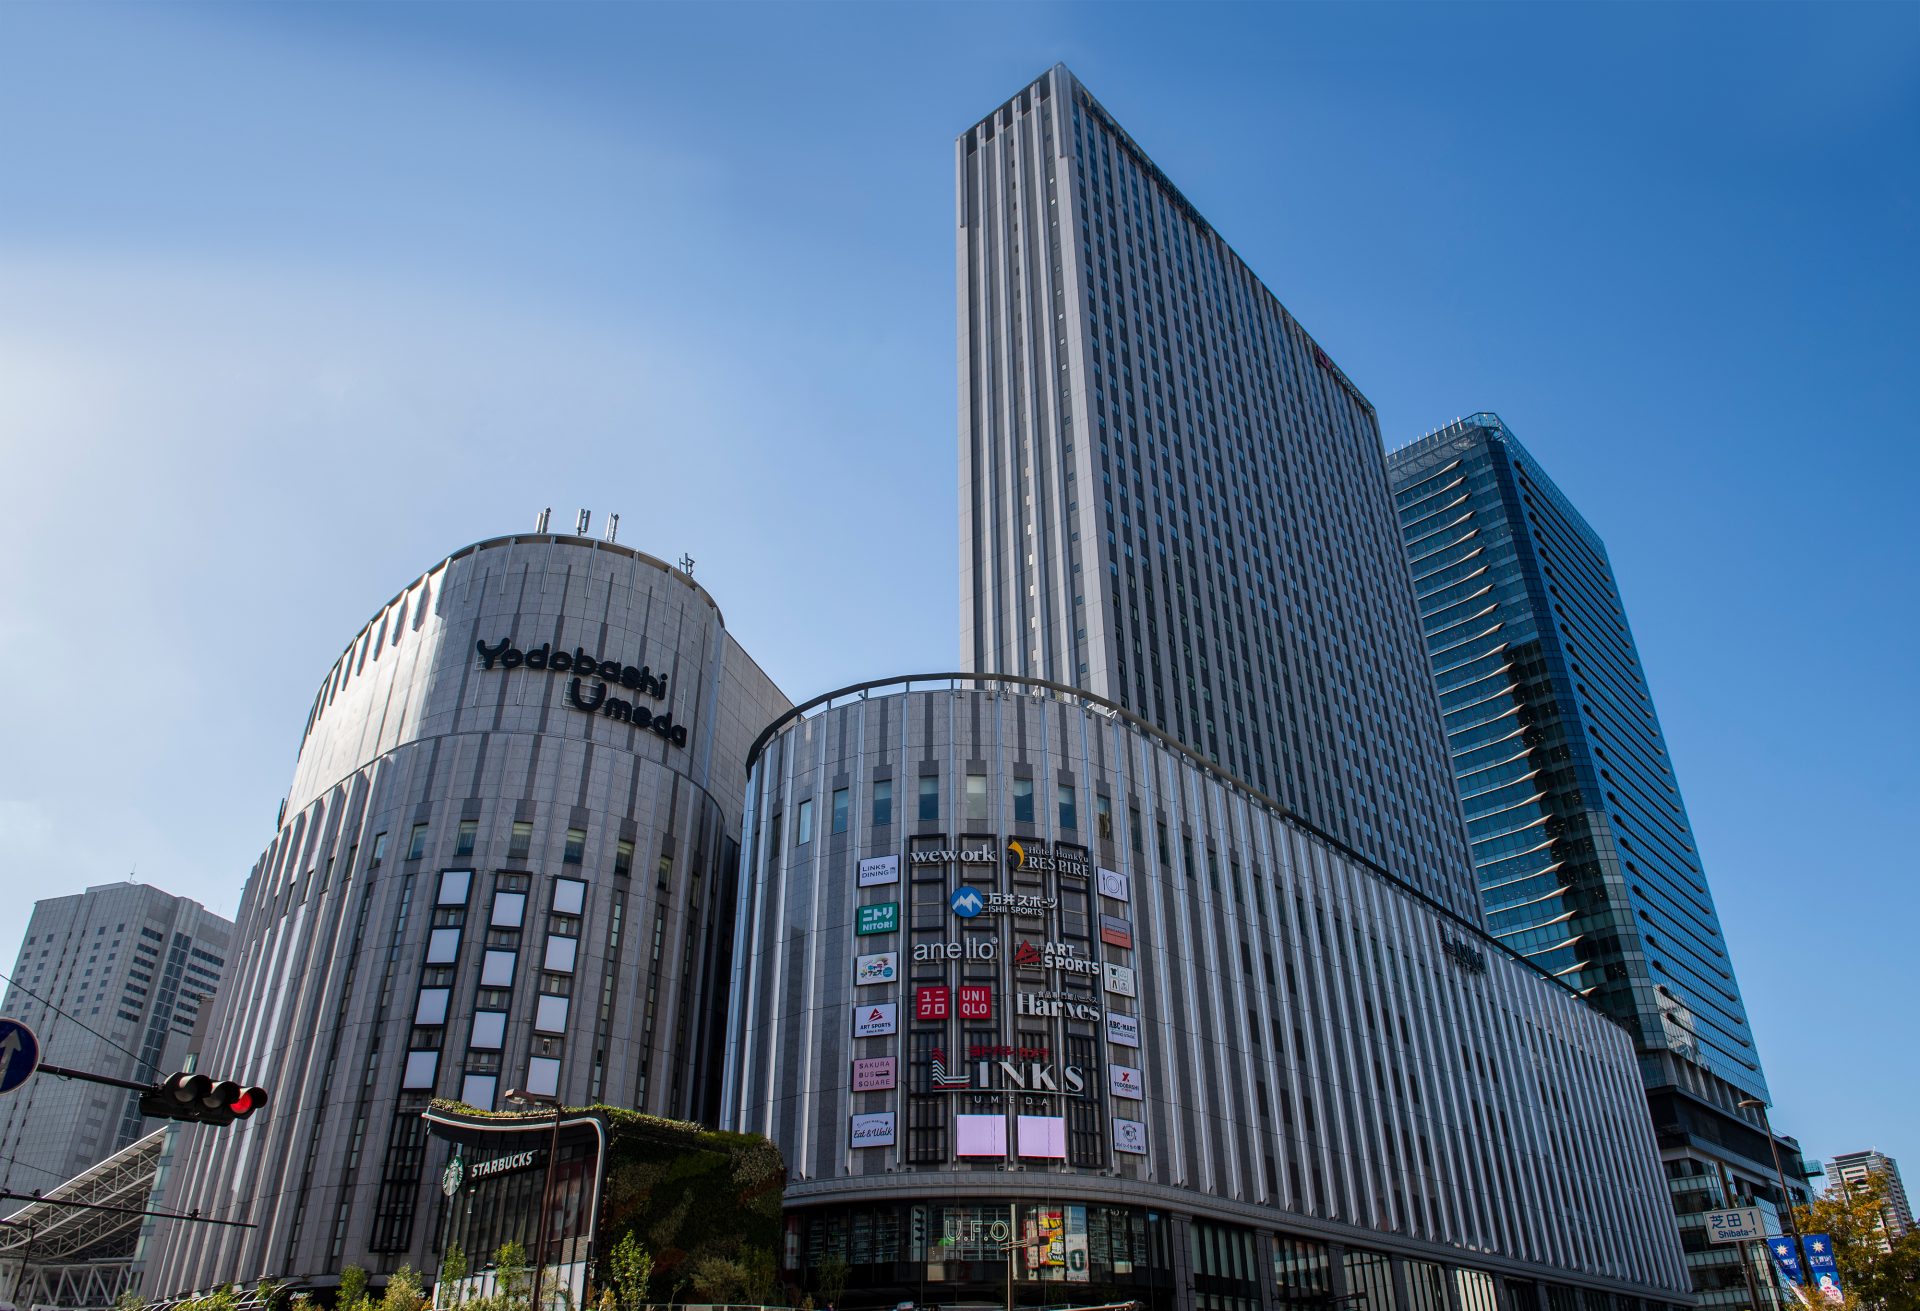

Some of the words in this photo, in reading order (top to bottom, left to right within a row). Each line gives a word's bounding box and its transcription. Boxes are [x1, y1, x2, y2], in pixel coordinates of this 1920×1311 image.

[477, 637, 668, 700] Yodobashi
[571, 677, 688, 748] Umeda
[910, 843, 997, 863] wework
[1028, 846, 1053, 855] Hotel
[1056, 849, 1089, 863] Hankyu
[862, 863, 886, 872] LINKS
[1028, 856, 1090, 876] RESPIRE
[862, 869, 889, 878] DINING
[988, 893, 1058, 909] 石井スポーツ
[862, 906, 893, 922] ニトリ
[988, 905, 1008, 913] ISHII
[1010, 906, 1044, 916] SPORTS
[862, 921, 893, 931] NITORI
[1045, 942, 1075, 957] ART
[1044, 956, 1100, 975] SPORTS
[962, 990, 985, 1001] UNI
[962, 1003, 988, 1015] QLO
[1016, 992, 1101, 1021] Harves
[1109, 1020, 1136, 1033] ABC-MART
[859, 1060, 890, 1069] SAKURA
[932, 1048, 1084, 1093] LINKS
[859, 1071, 874, 1079] BUS
[858, 1078, 890, 1088] SQUARE
[1114, 1081, 1139, 1091] YODOBASHI
[974, 1096, 1049, 1106] UMEDA
[853, 1129, 866, 1138] Eat
[866, 1129, 871, 1137] &
[871, 1126, 893, 1137] Walk
[471, 1151, 533, 1178] STARBUCKS
[1710, 1213, 1742, 1229] 芝田
[1747, 1210, 1756, 1226] 1
[1718, 1227, 1757, 1239] Shibata-1
